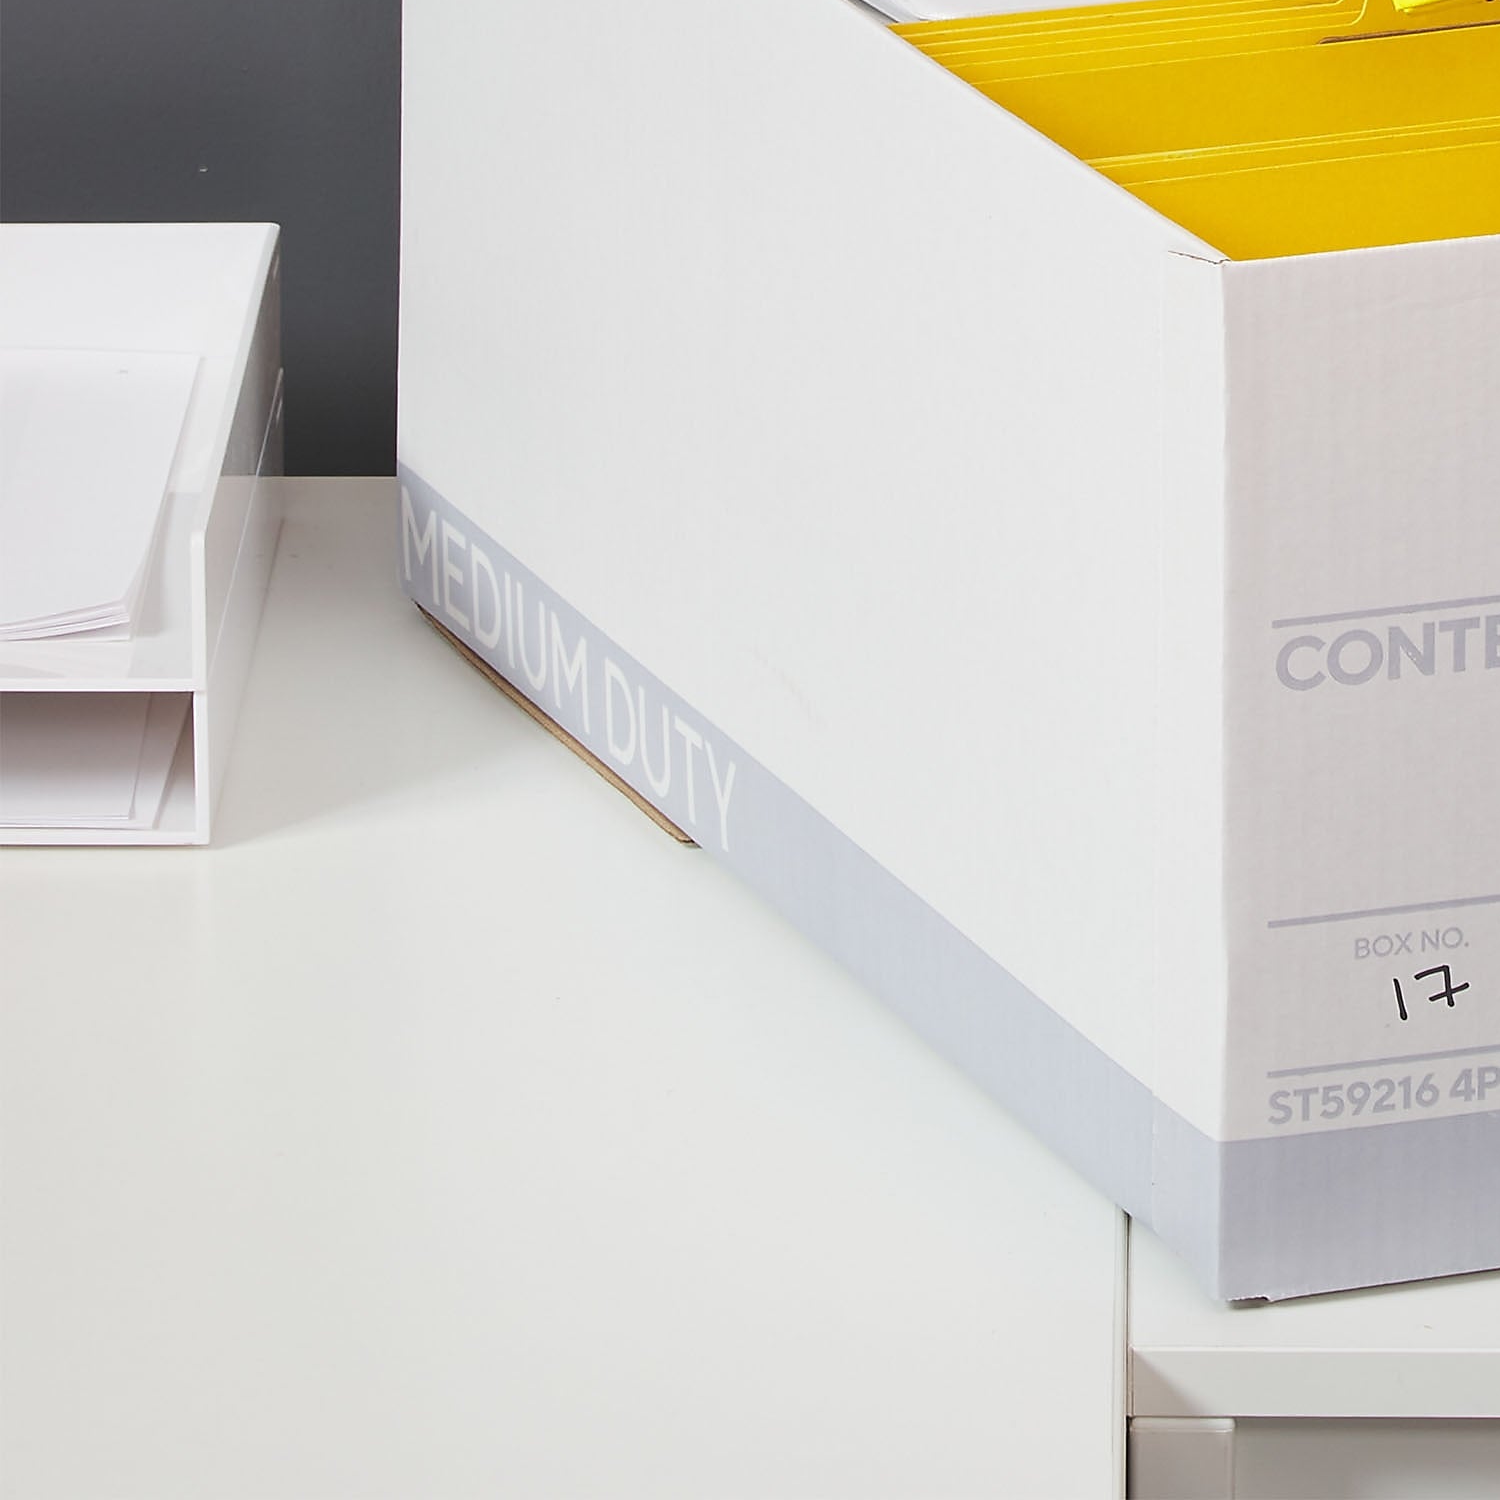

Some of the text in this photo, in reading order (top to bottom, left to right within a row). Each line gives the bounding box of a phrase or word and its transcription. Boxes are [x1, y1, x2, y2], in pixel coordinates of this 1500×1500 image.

[401, 485, 736, 853] MEDIUM DUTY
[1354, 927, 1470, 960] BOX NO.
[1392, 964, 1470, 1021] 17
[1267, 1078, 1440, 1126] ST59216
